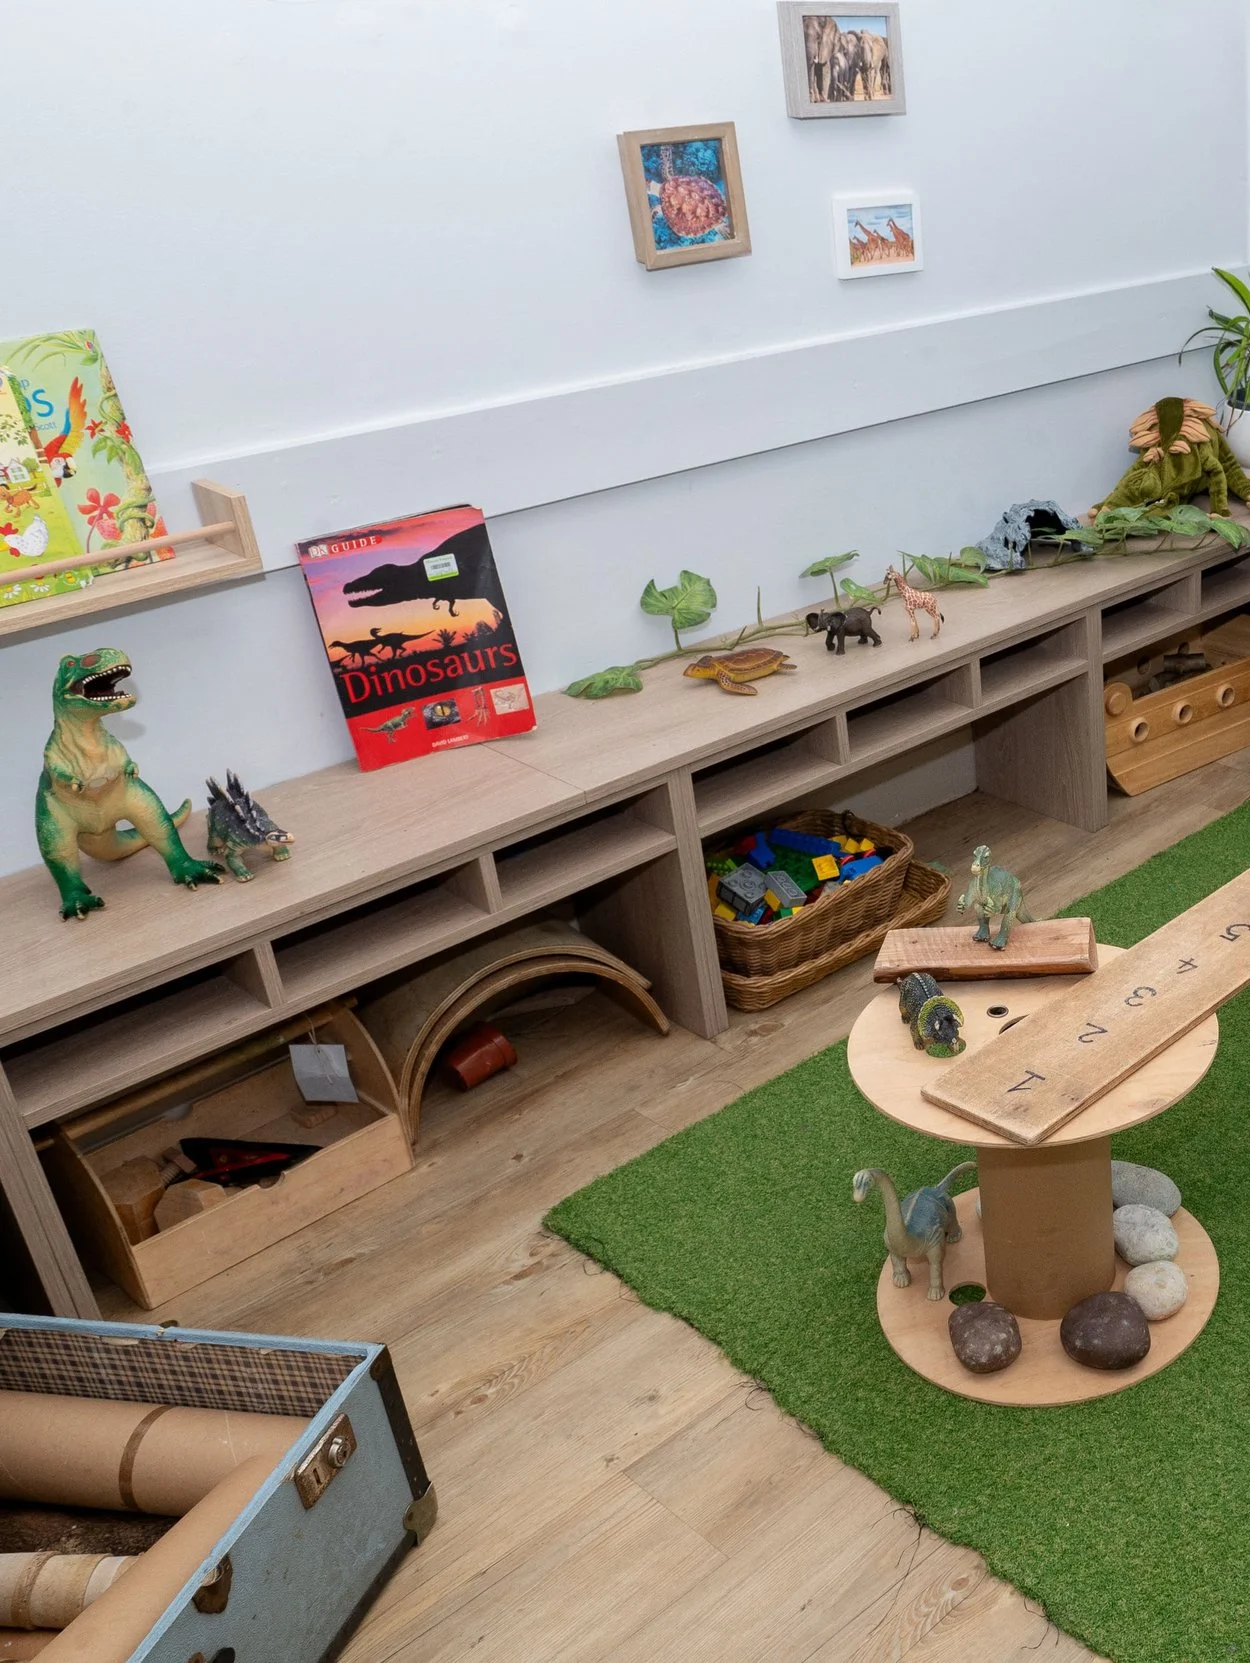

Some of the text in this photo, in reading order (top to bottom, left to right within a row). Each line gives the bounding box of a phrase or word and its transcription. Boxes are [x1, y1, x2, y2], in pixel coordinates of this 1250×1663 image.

[331, 536, 377, 553] GUIDE
[340, 643, 518, 703] Dinosaurs
[1176, 957, 1199, 975] 4
[1124, 986, 1157, 1007] 3
[1077, 1022, 1108, 1043] 2
[1006, 1070, 1046, 1093] 1
